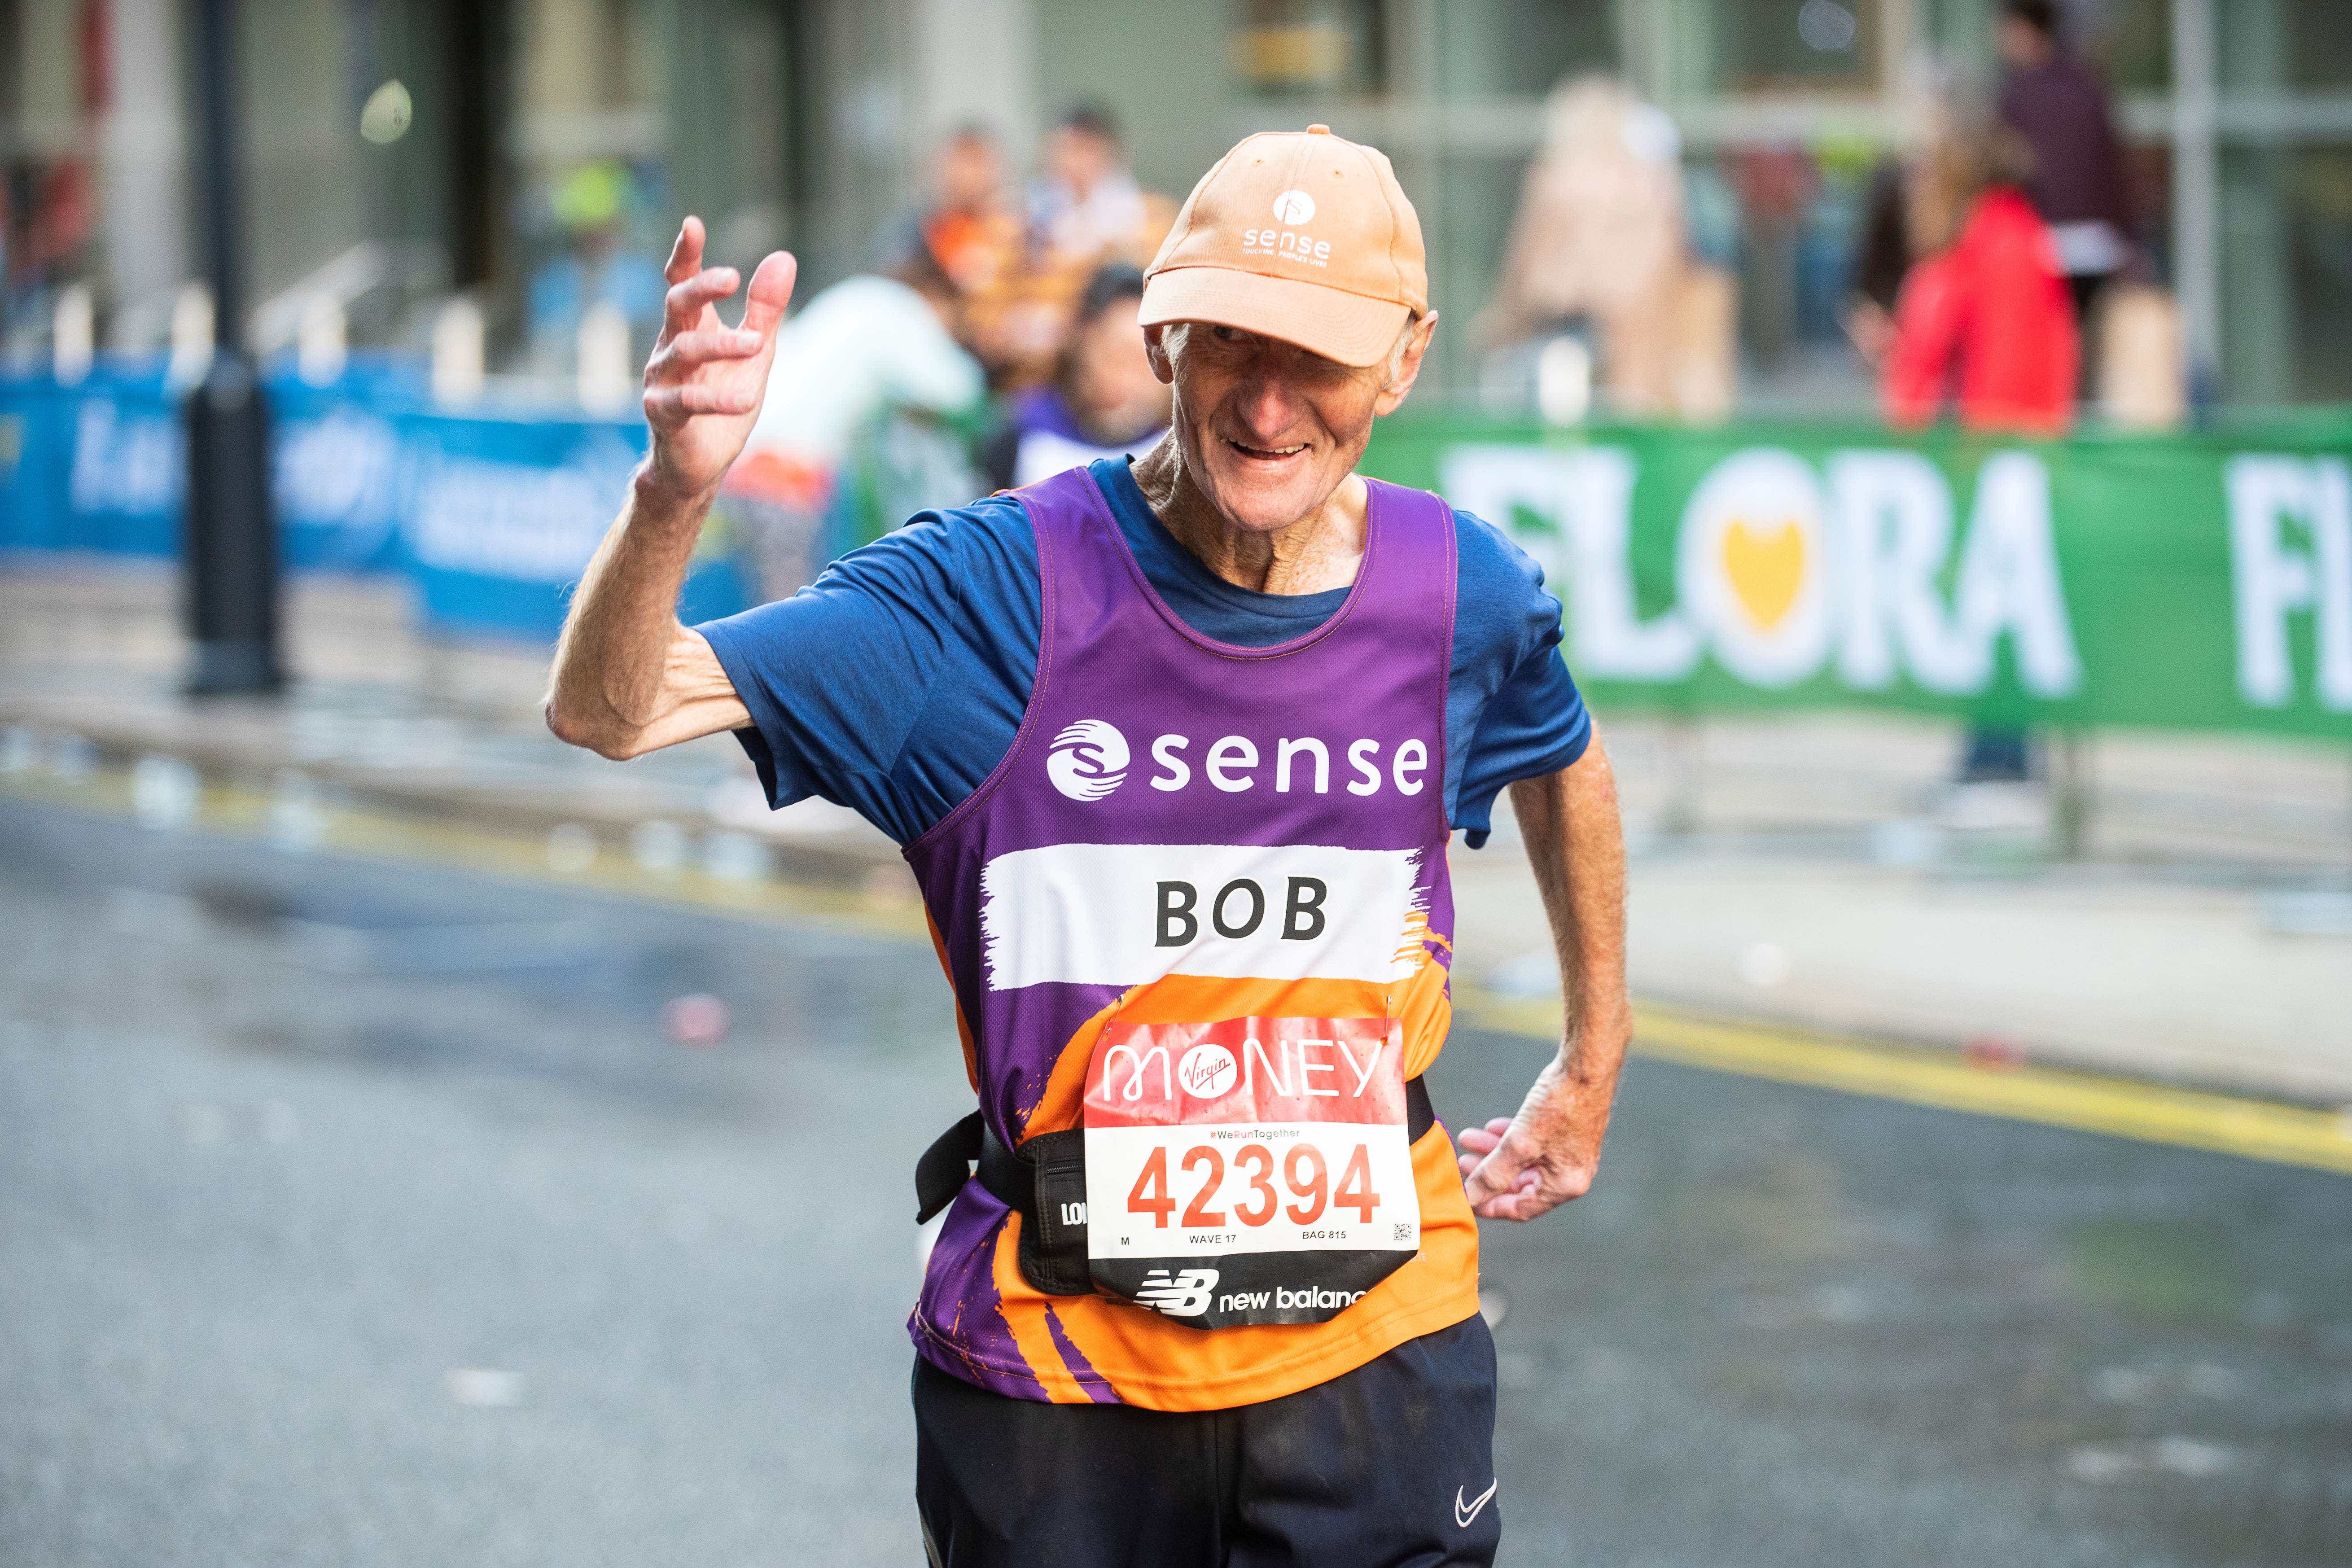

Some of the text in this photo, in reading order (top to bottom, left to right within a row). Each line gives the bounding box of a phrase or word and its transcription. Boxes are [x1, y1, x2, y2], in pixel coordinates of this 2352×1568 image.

[1244, 229, 1331, 259] sense
[1150, 734, 1428, 796] sense
[1154, 876, 1328, 947] BOB
[1185, 1052, 1231, 1090] Virgin
[1210, 1130, 1299, 1140] #WeRunTogether
[1127, 1143, 1380, 1228] 42394
[1189, 1235, 1236, 1244] WAVE 17
[1219, 1291, 1270, 1313] new
